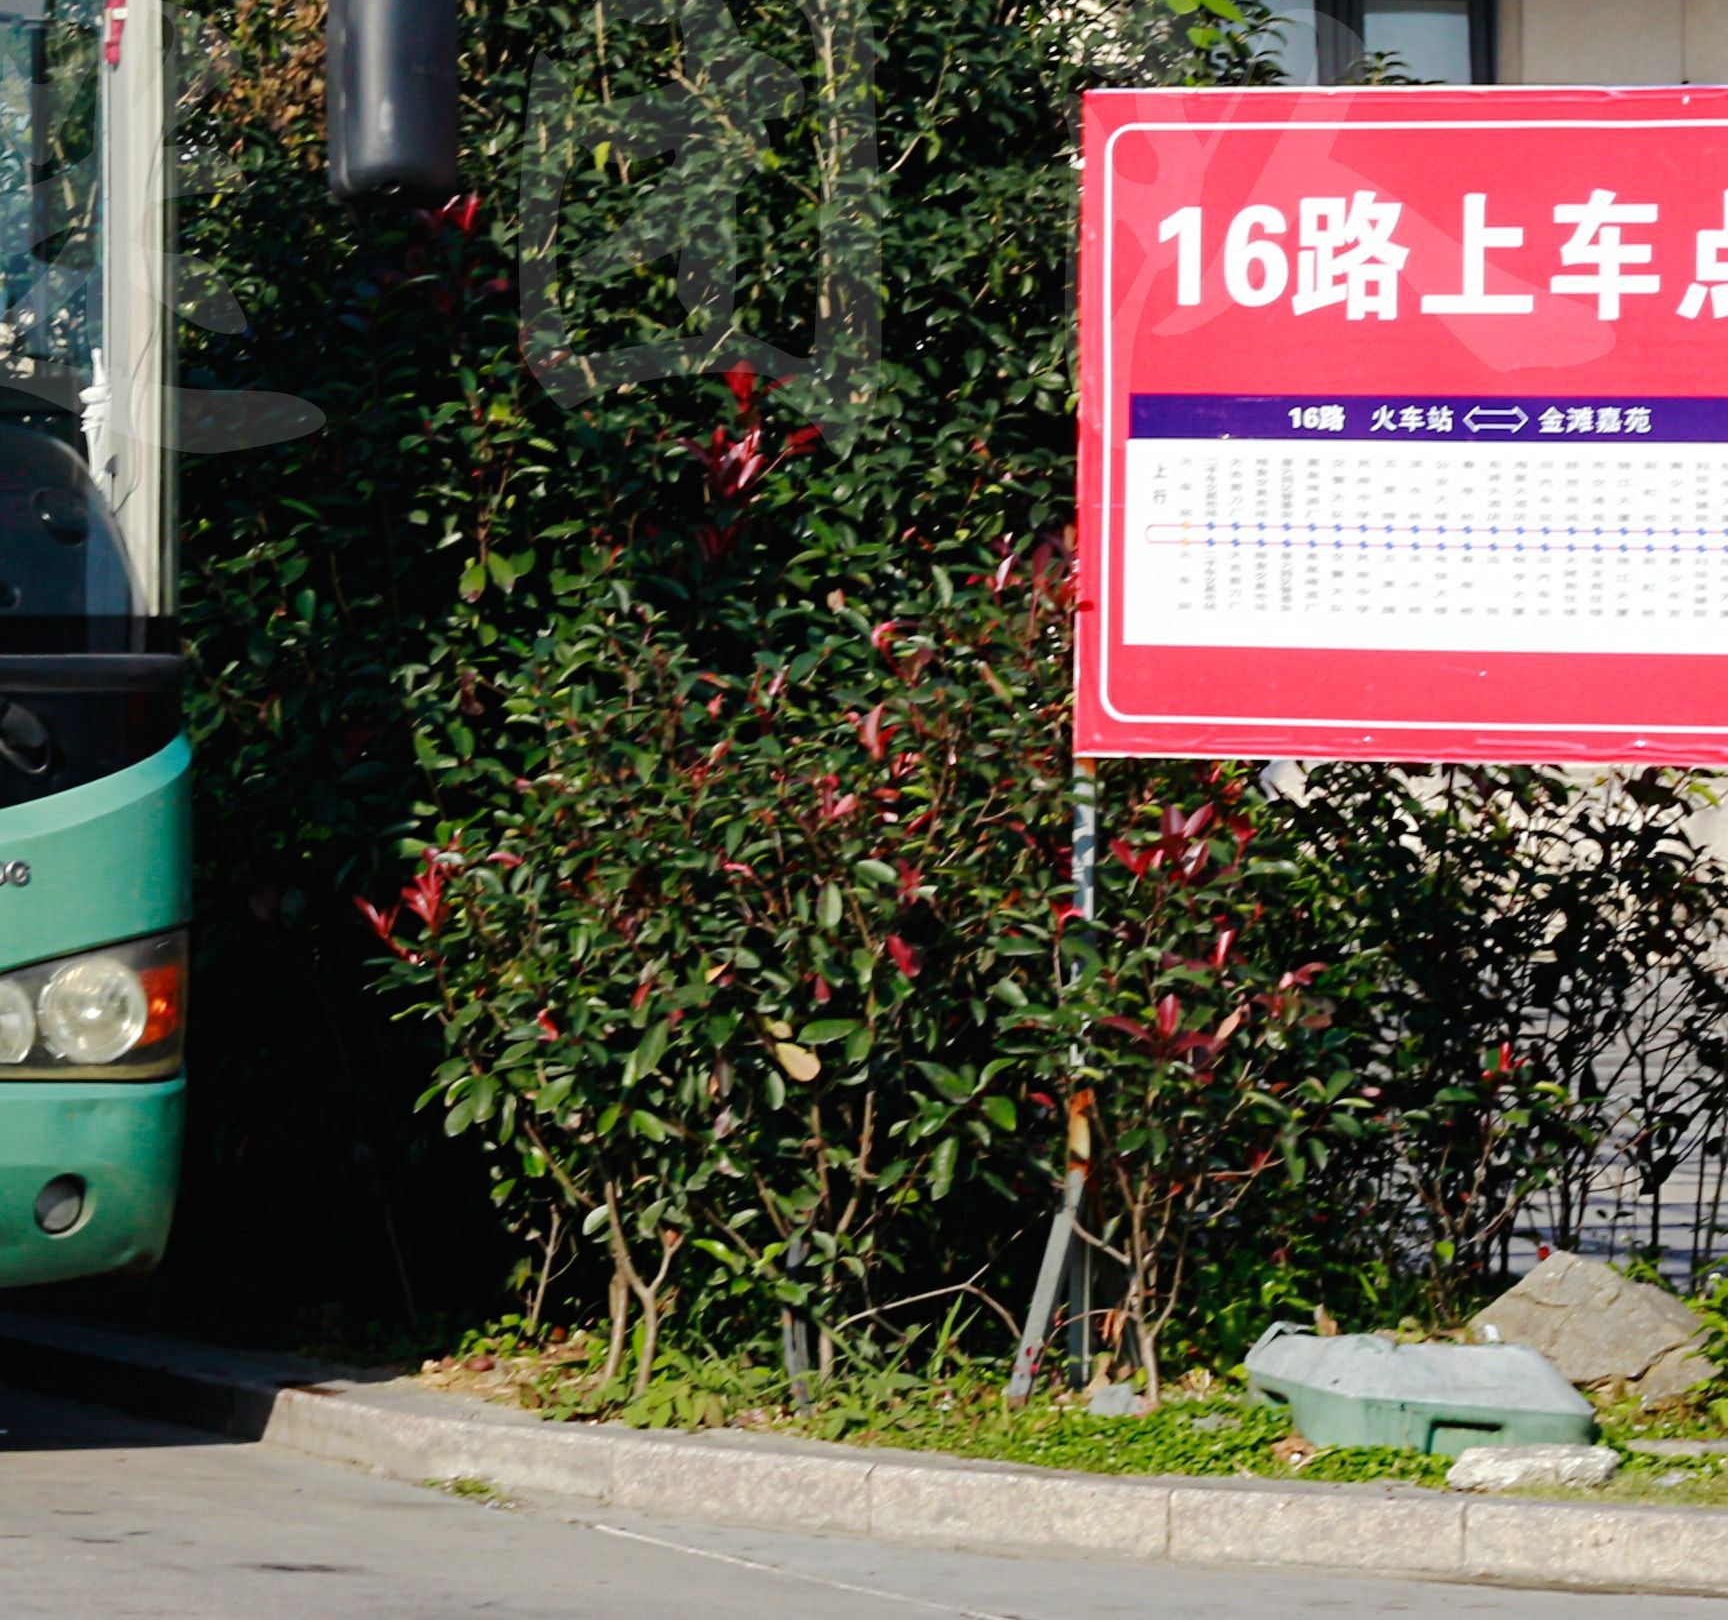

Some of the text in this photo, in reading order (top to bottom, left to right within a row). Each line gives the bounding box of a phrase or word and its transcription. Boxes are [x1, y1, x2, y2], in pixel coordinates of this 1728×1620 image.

[1287, 404, 1653, 435] 16路 火车站 金滩嘉苑
